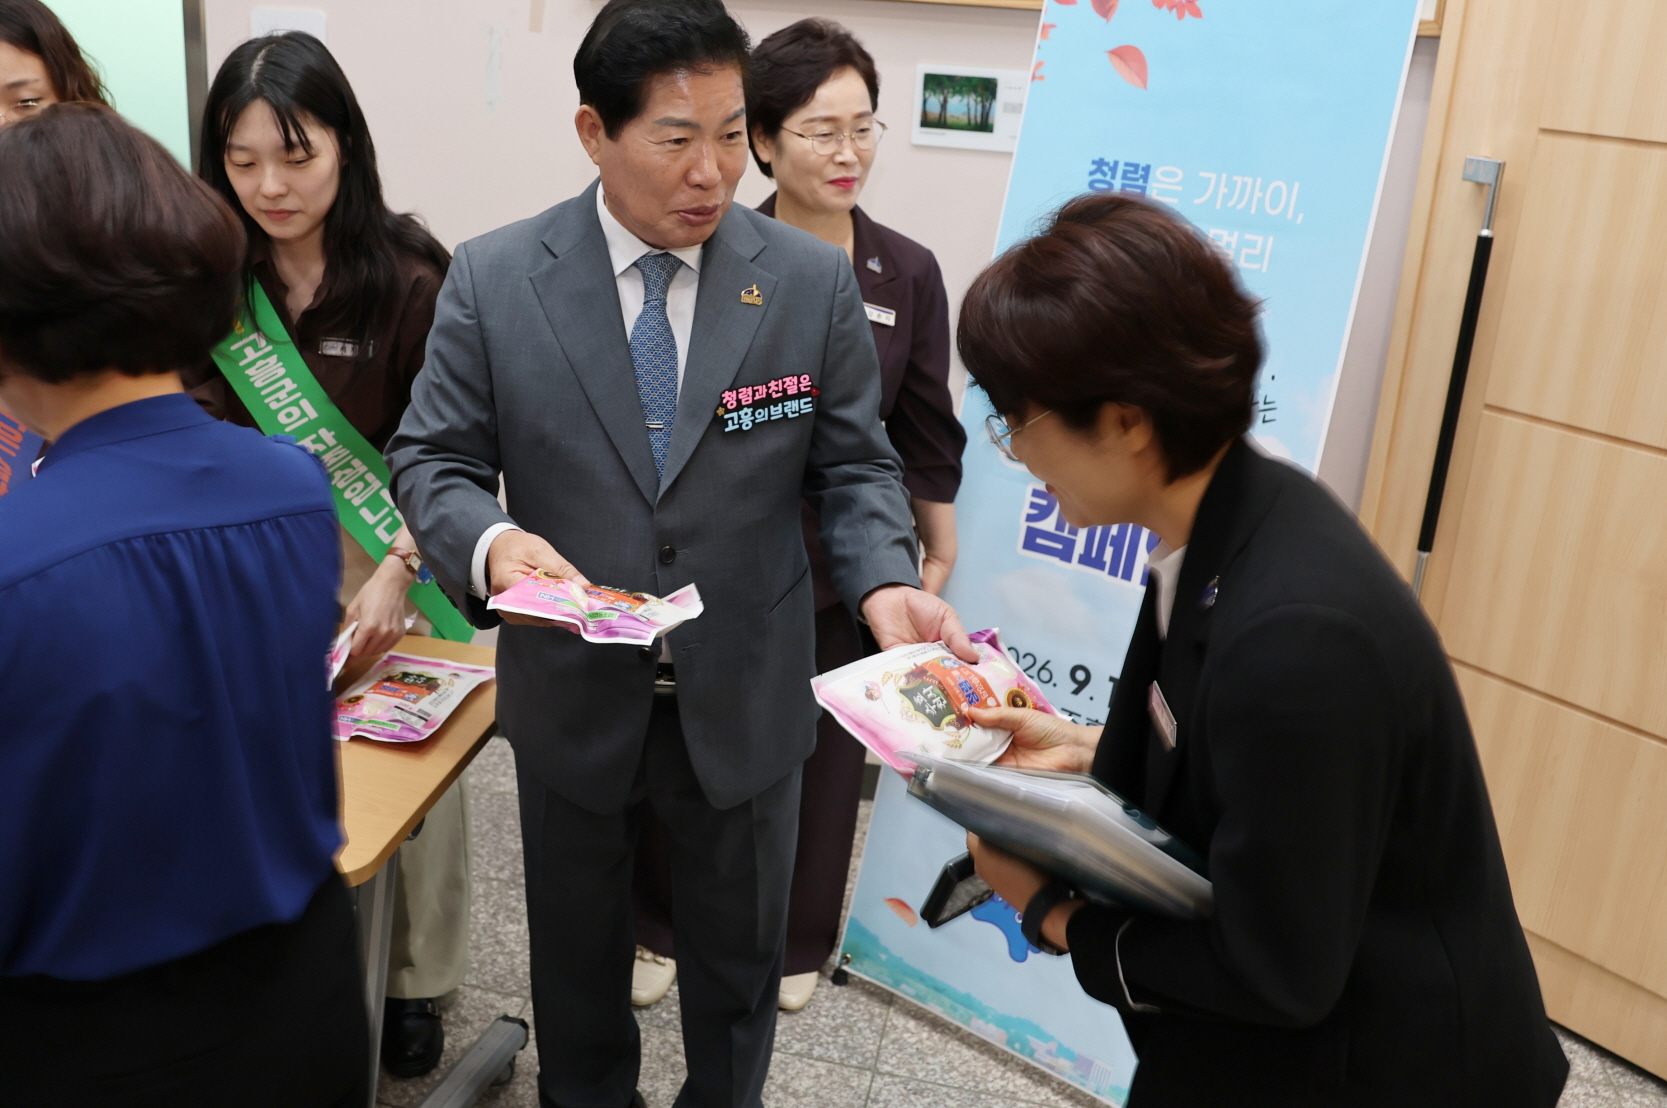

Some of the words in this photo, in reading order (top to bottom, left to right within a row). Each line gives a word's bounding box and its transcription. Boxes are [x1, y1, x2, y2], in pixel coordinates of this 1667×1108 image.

[1088, 158, 1184, 203] 청렴은
[1193, 171, 1305, 225] 가까이,
[230, 331, 319, 432] 고흥군의
[1022, 488, 1161, 587] 캠페
[1069, 664, 1094, 701] 9.
